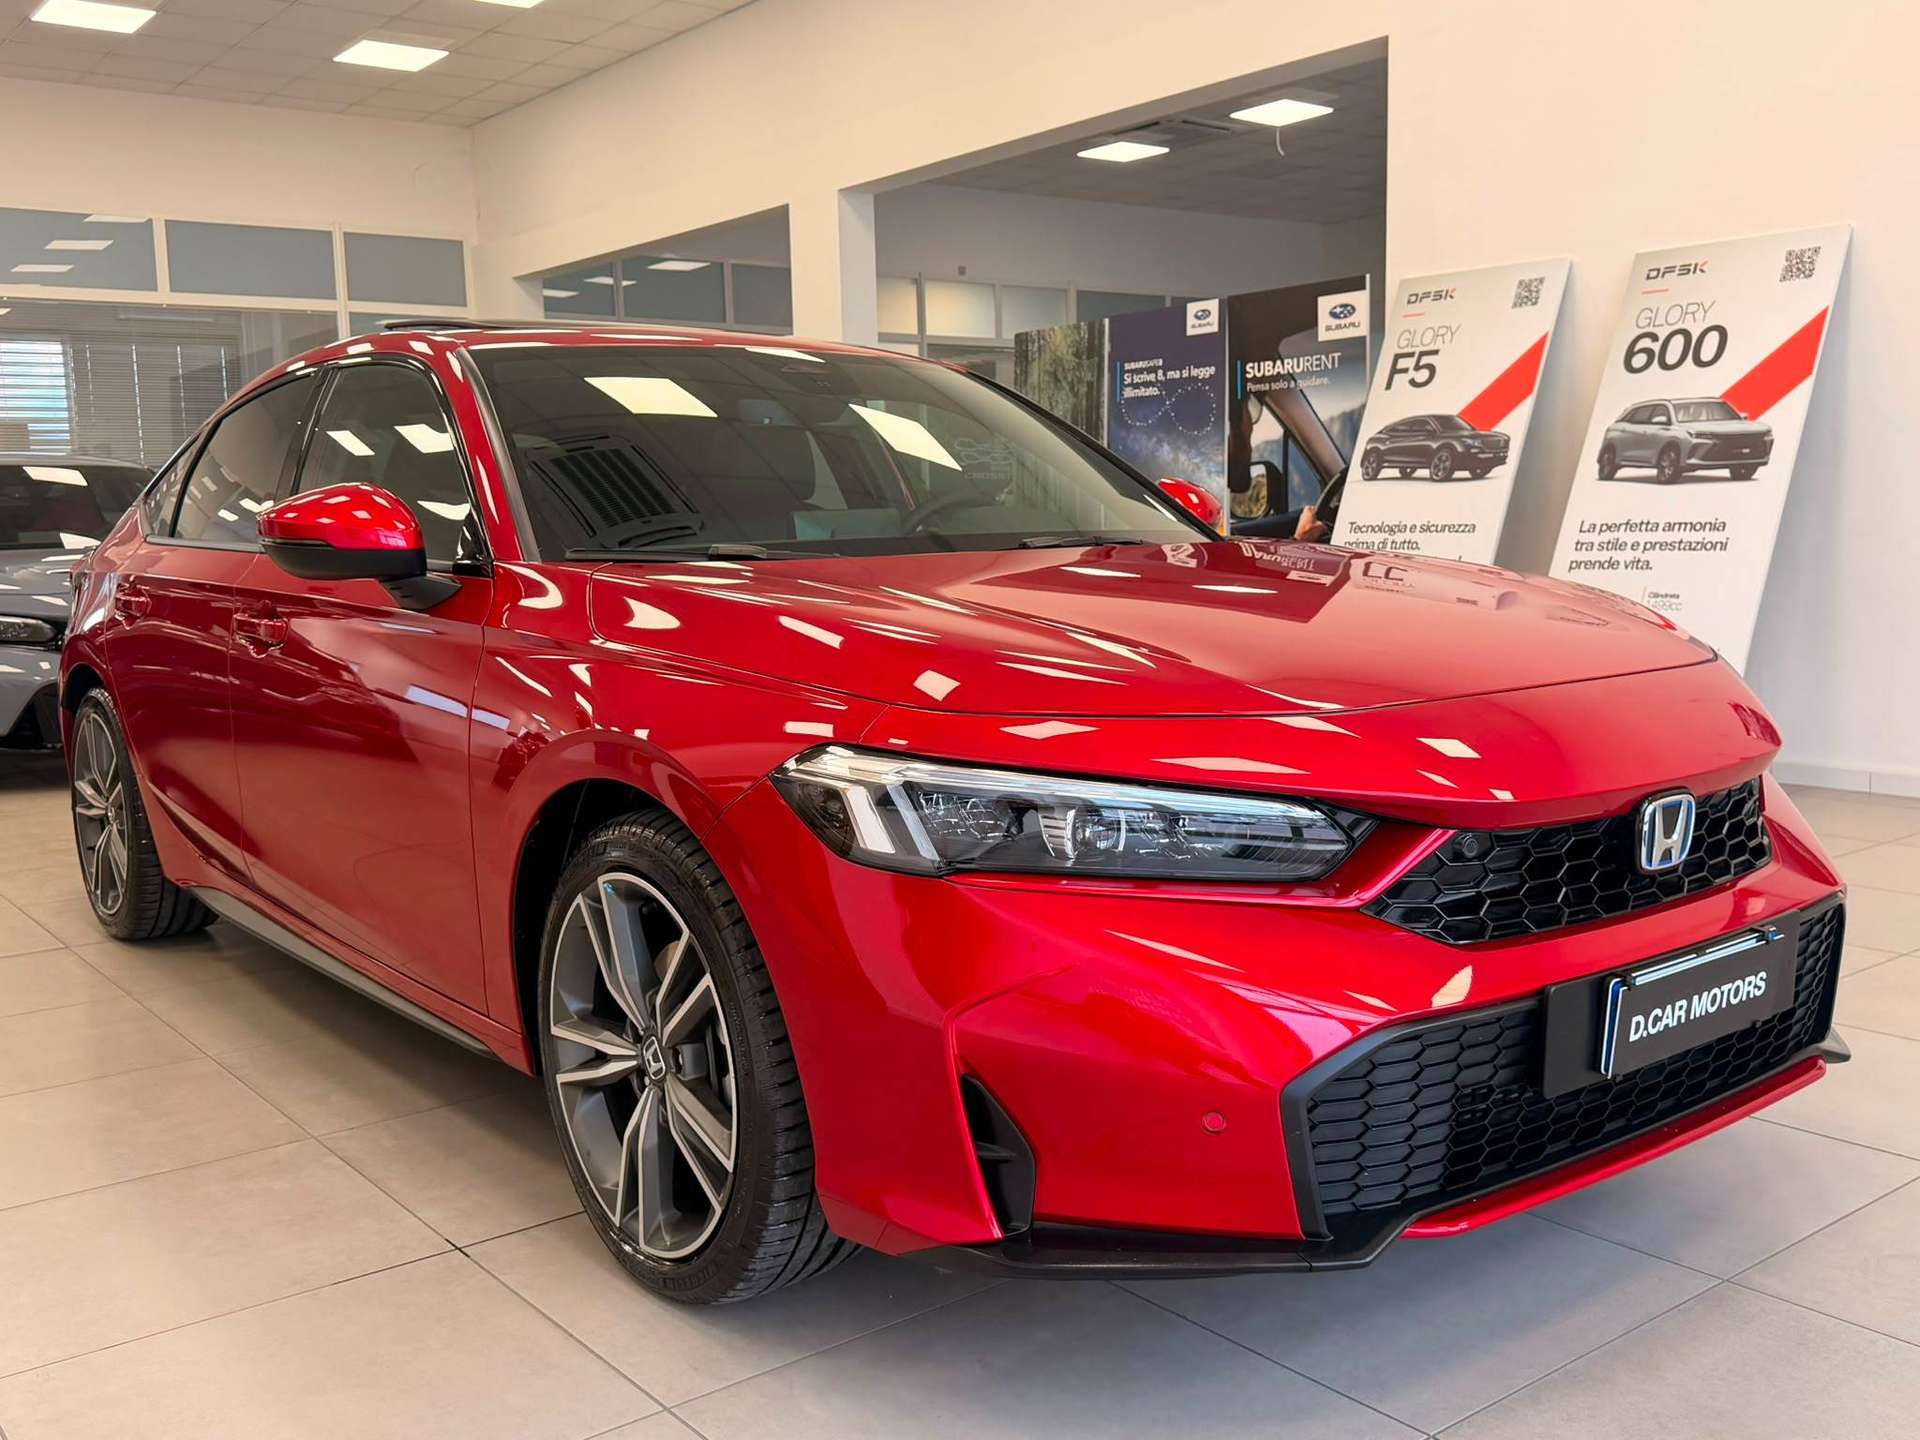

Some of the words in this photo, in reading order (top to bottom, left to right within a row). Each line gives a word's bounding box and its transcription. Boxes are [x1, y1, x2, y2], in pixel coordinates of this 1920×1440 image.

[1646, 260, 1709, 281] DFSK
[1407, 288, 1456, 305] DFSK
[1635, 300, 1716, 329] GLORY
[1325, 321, 1361, 332] SUBARU
[1396, 323, 1462, 349] GLORY
[1623, 324, 1728, 374] 600
[1245, 352, 1341, 378] SUBARURENT
[1385, 349, 1440, 391] F5
[1124, 373, 1132, 384] Si
[1133, 371, 1156, 383] scrive
[1167, 370, 1180, 379] ma
[1182, 366, 1189, 378] si
[1190, 365, 1216, 379] legge
[1247, 382, 1269, 392] Pensa
[1271, 379, 1288, 390] solo
[1289, 381, 1296, 389] a
[1348, 521, 1408, 536] Tecnologia
[1409, 524, 1417, 534] e
[1420, 521, 1477, 534] sicurezza
[1579, 520, 1596, 533] La
[1598, 519, 1659, 535] perfetta
[1662, 518, 1727, 532] armonia
[1377, 538, 1388, 551] di
[1390, 539, 1421, 550] tutto.
[1575, 539, 1594, 552] tra
[1597, 538, 1627, 551] stile
[1630, 540, 1641, 551] e
[1642, 537, 1730, 553] prestazioni
[1568, 556, 1620, 573] prende
[1624, 557, 1653, 570] vita.
[1629, 999, 1688, 1042] D.CAR
[1690, 971, 1767, 1020] MOTORS
